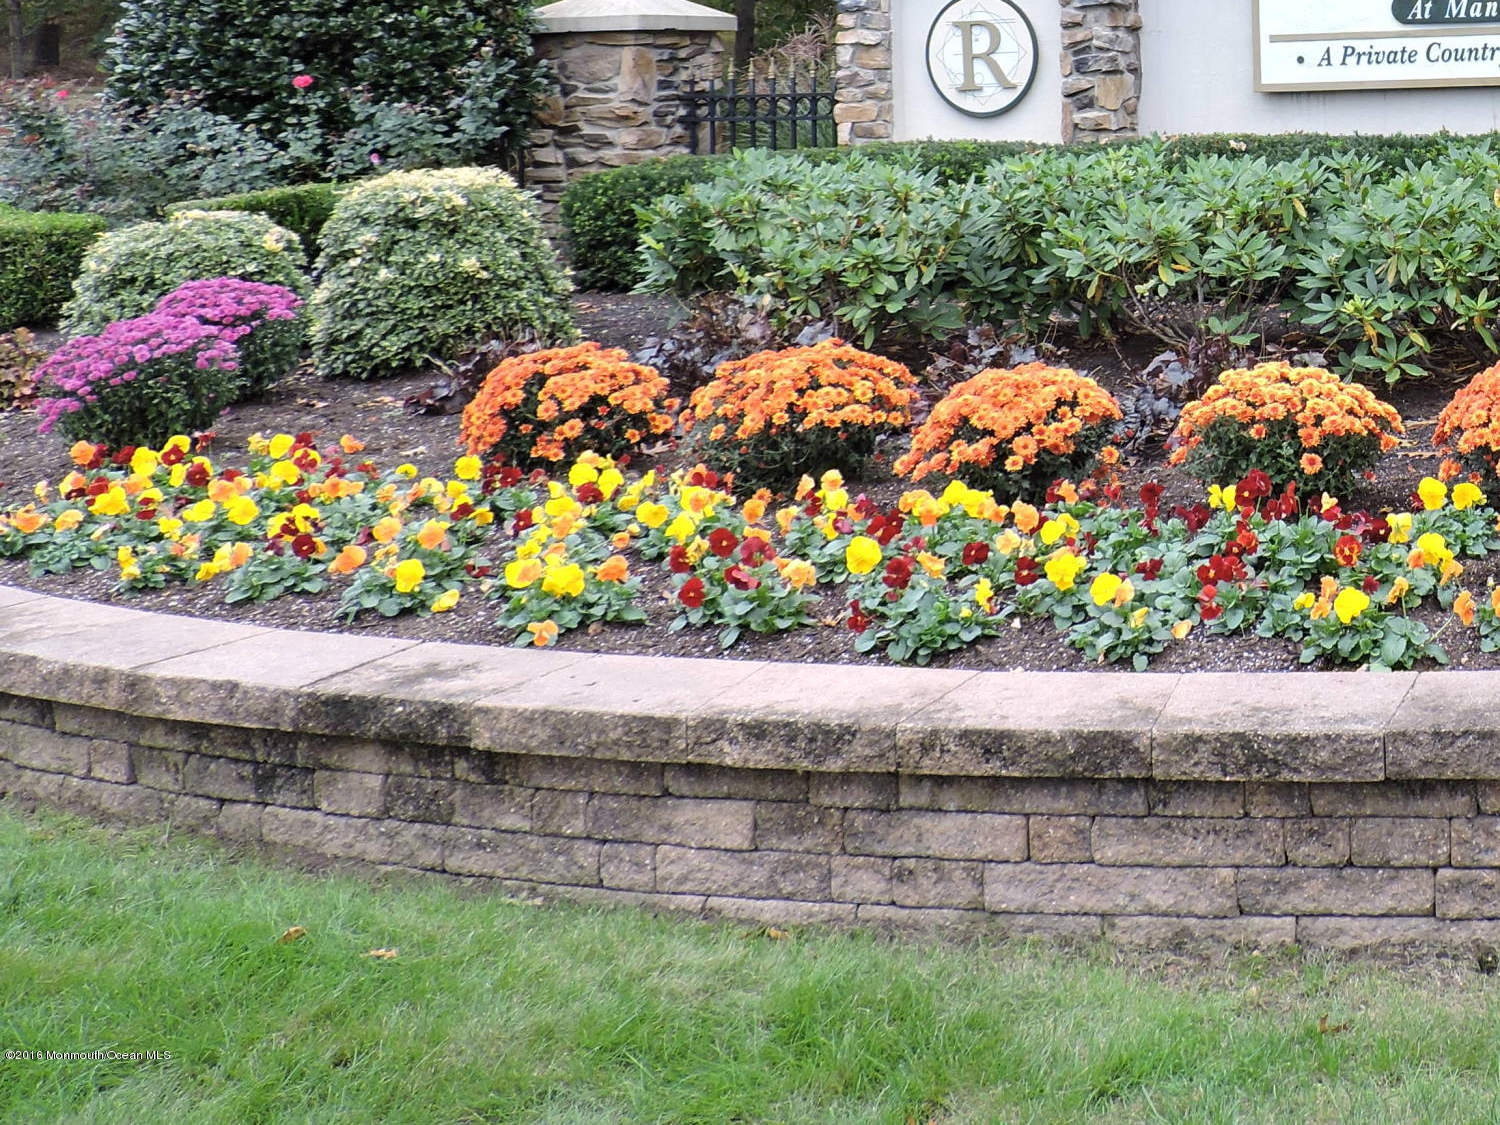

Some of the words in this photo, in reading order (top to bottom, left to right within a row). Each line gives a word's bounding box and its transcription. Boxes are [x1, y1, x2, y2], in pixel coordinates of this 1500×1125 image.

[951, 19, 1018, 92] R
[1316, 46, 1333, 68] A
[1340, 44, 1419, 67] Private
